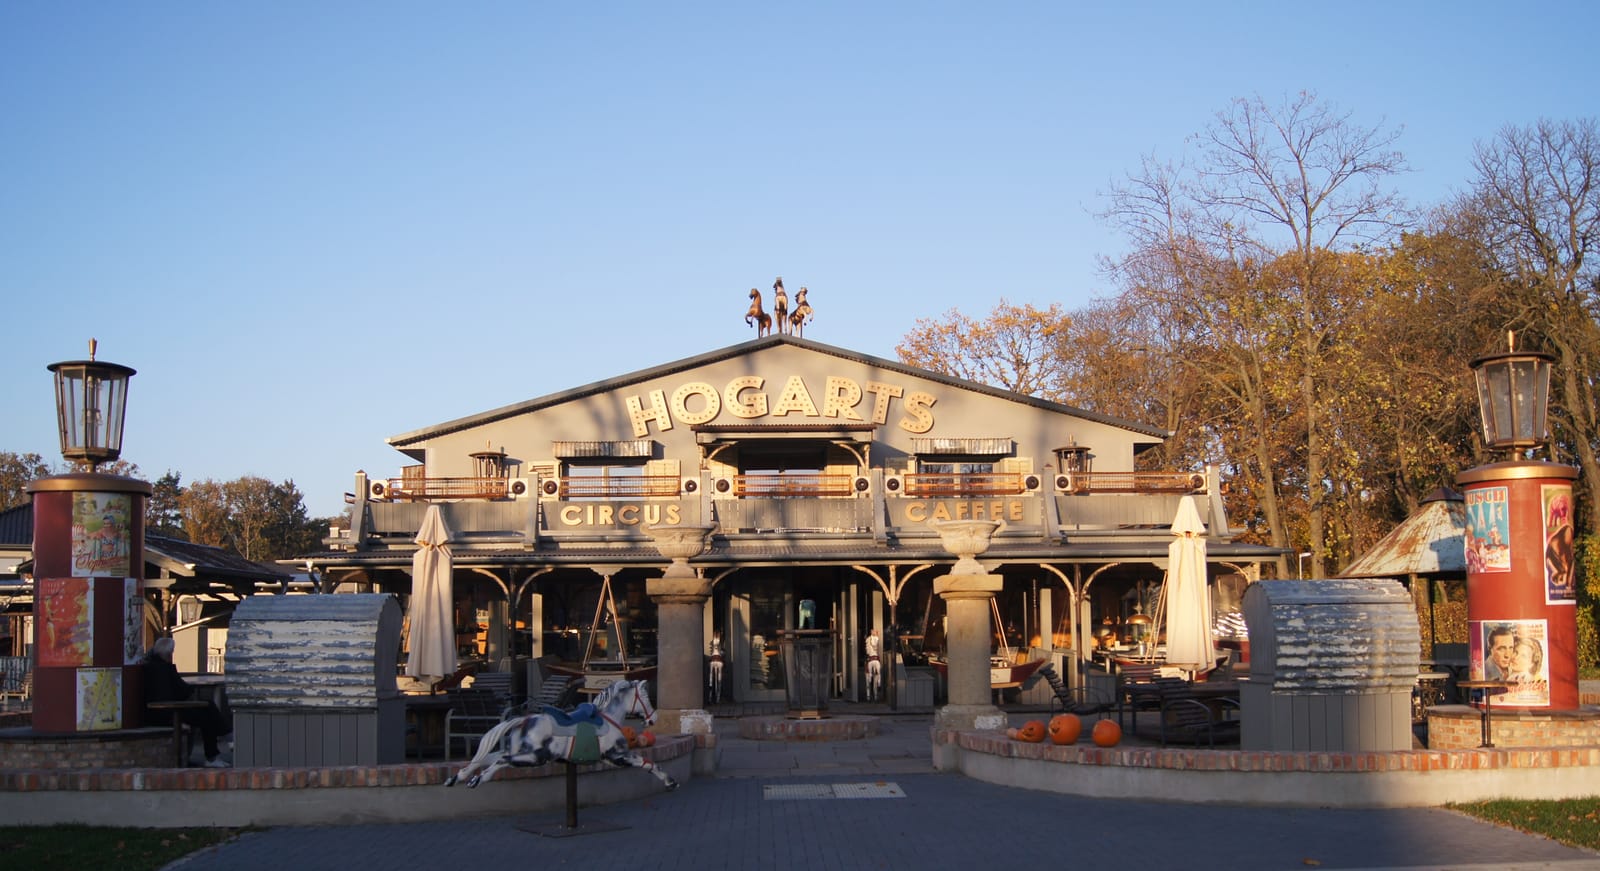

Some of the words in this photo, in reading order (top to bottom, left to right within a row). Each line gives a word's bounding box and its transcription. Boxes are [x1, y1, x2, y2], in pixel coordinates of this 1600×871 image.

[625, 375, 938, 438] HOGARTS
[560, 504, 681, 526] CIRCUS
[904, 501, 1024, 522] CAFFEE
